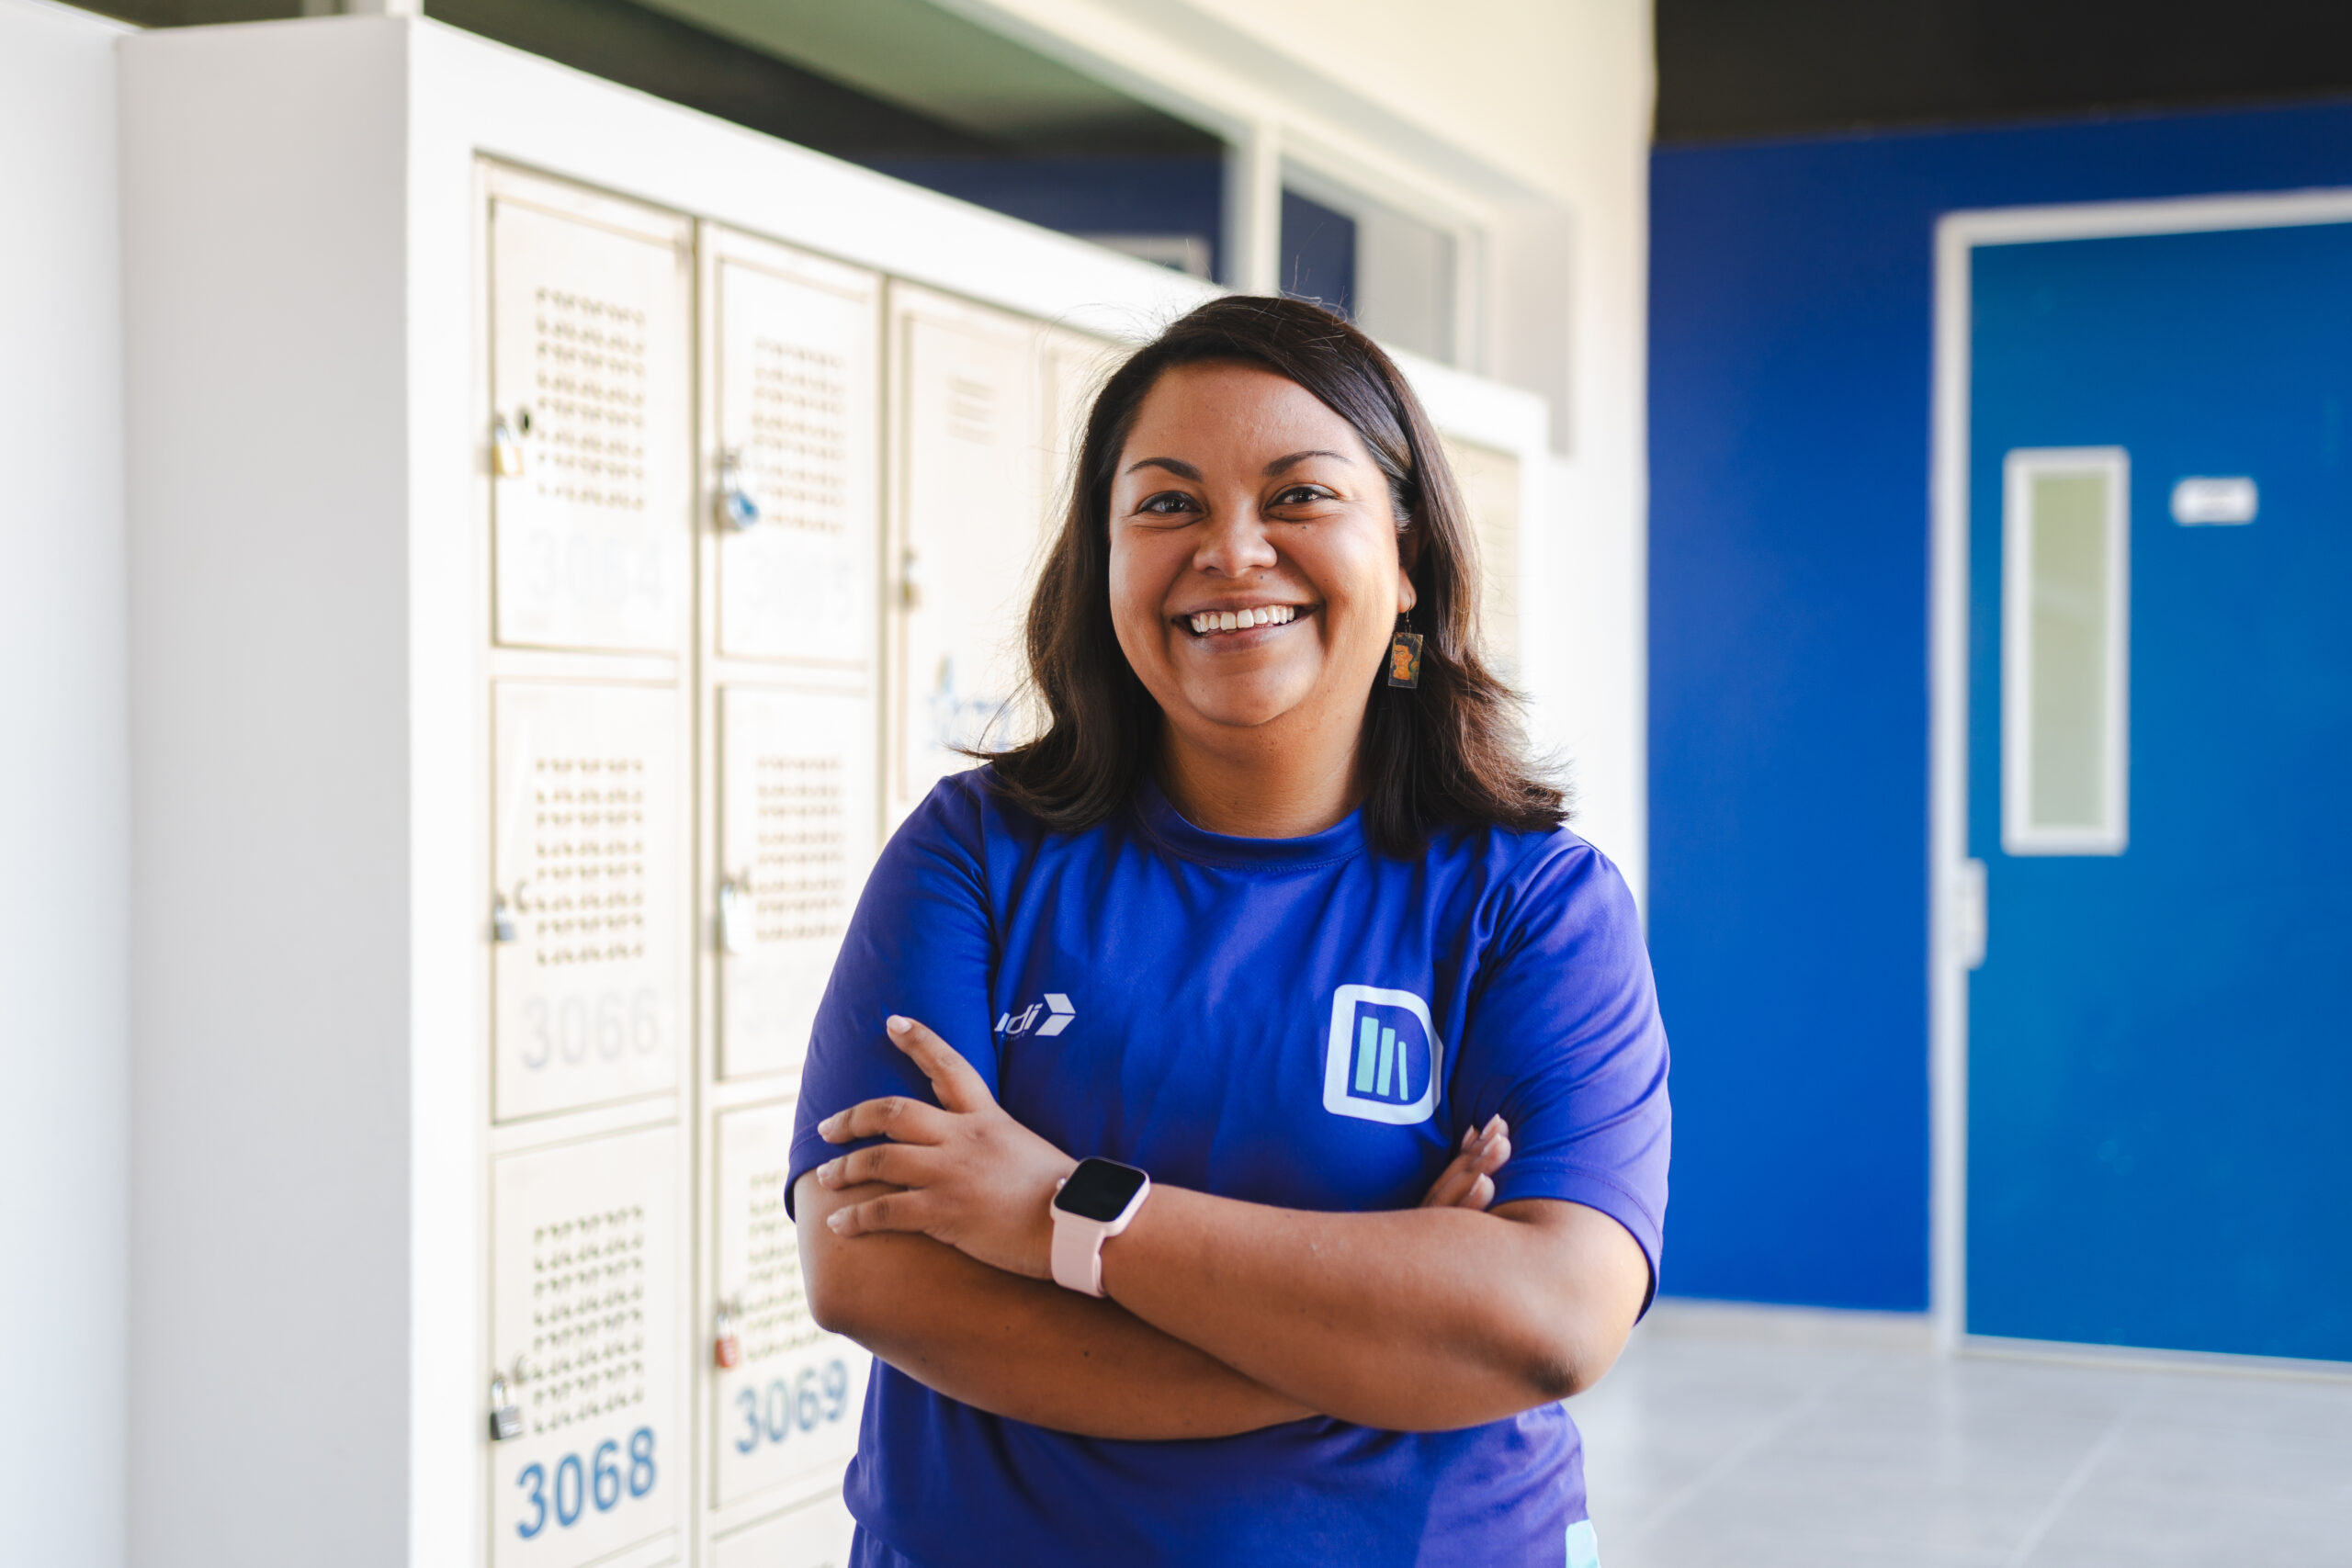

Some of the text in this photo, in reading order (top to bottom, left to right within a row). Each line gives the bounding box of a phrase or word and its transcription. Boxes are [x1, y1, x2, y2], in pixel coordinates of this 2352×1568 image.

[522, 985, 659, 1071] 3066
[735, 1358, 848, 1455] 3069
[516, 1426, 656, 1540] 3068
